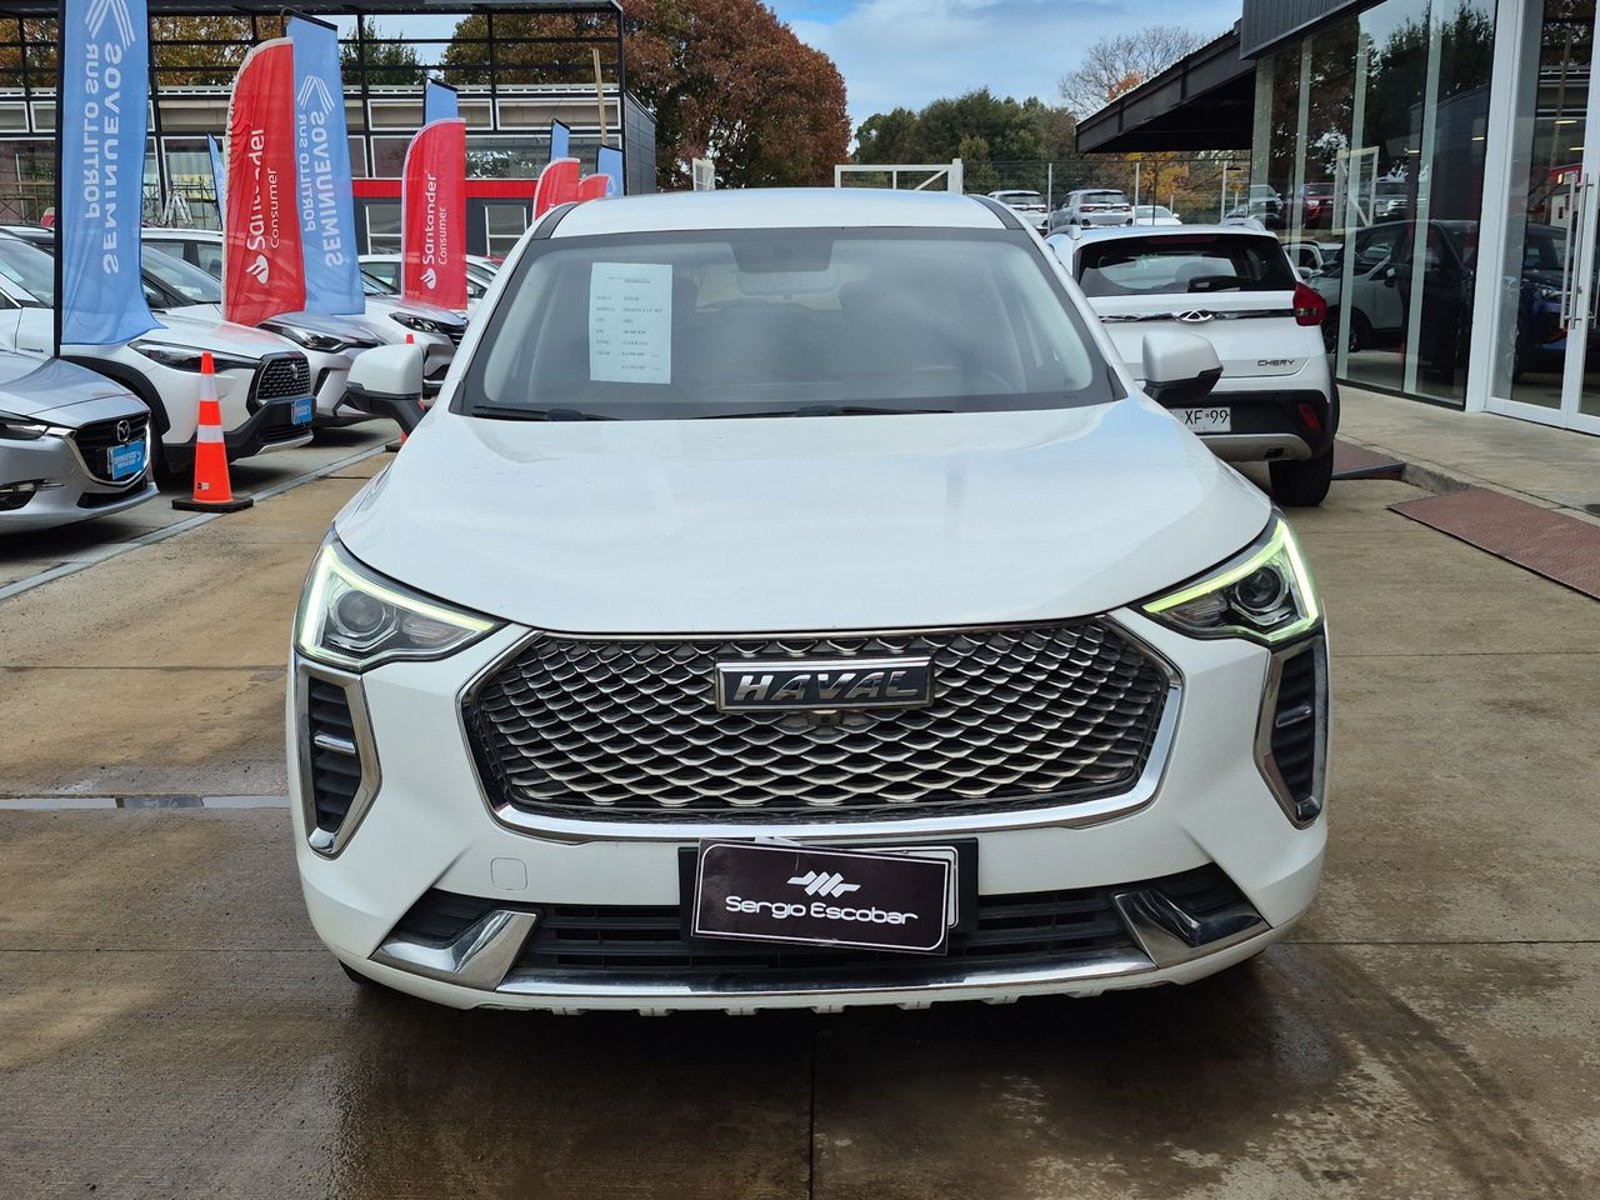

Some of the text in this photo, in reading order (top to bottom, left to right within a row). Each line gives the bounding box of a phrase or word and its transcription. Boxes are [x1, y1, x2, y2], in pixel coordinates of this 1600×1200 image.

[267, 167, 280, 249] Consumer
[422, 173, 437, 265] Santander
[438, 207, 448, 265] Consumer
[1257, 359, 1295, 367] CHERY
[733, 671, 918, 701] HAVAL
[725, 895, 919, 924] Sergio Escobar
